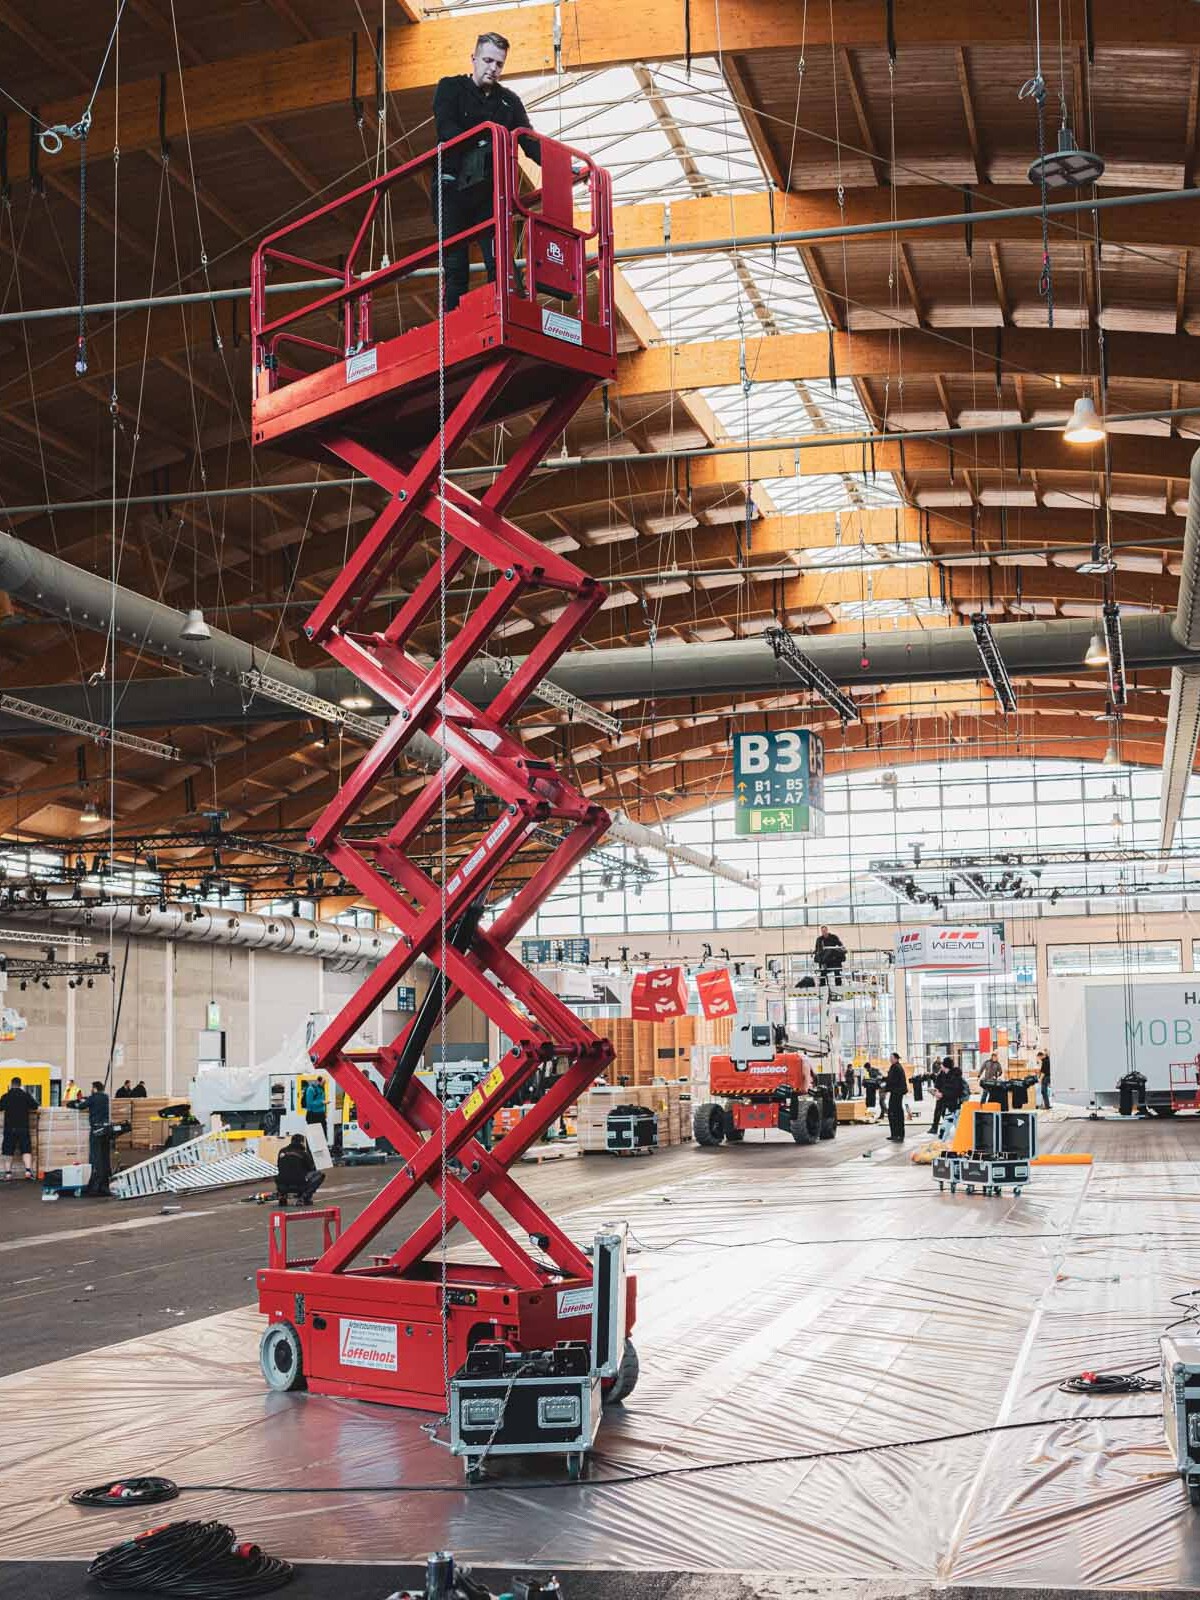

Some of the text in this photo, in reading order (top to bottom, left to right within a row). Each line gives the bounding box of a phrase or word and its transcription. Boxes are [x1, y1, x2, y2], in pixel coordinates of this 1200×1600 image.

[740, 732, 801, 774] B3
[755, 780, 771, 791] B1
[786, 779, 803, 790] B5
[753, 793, 771, 805] A1
[785, 792, 803, 804] A7
[932, 941, 984, 950] WEMO
[750, 1065, 788, 1074] mateco
